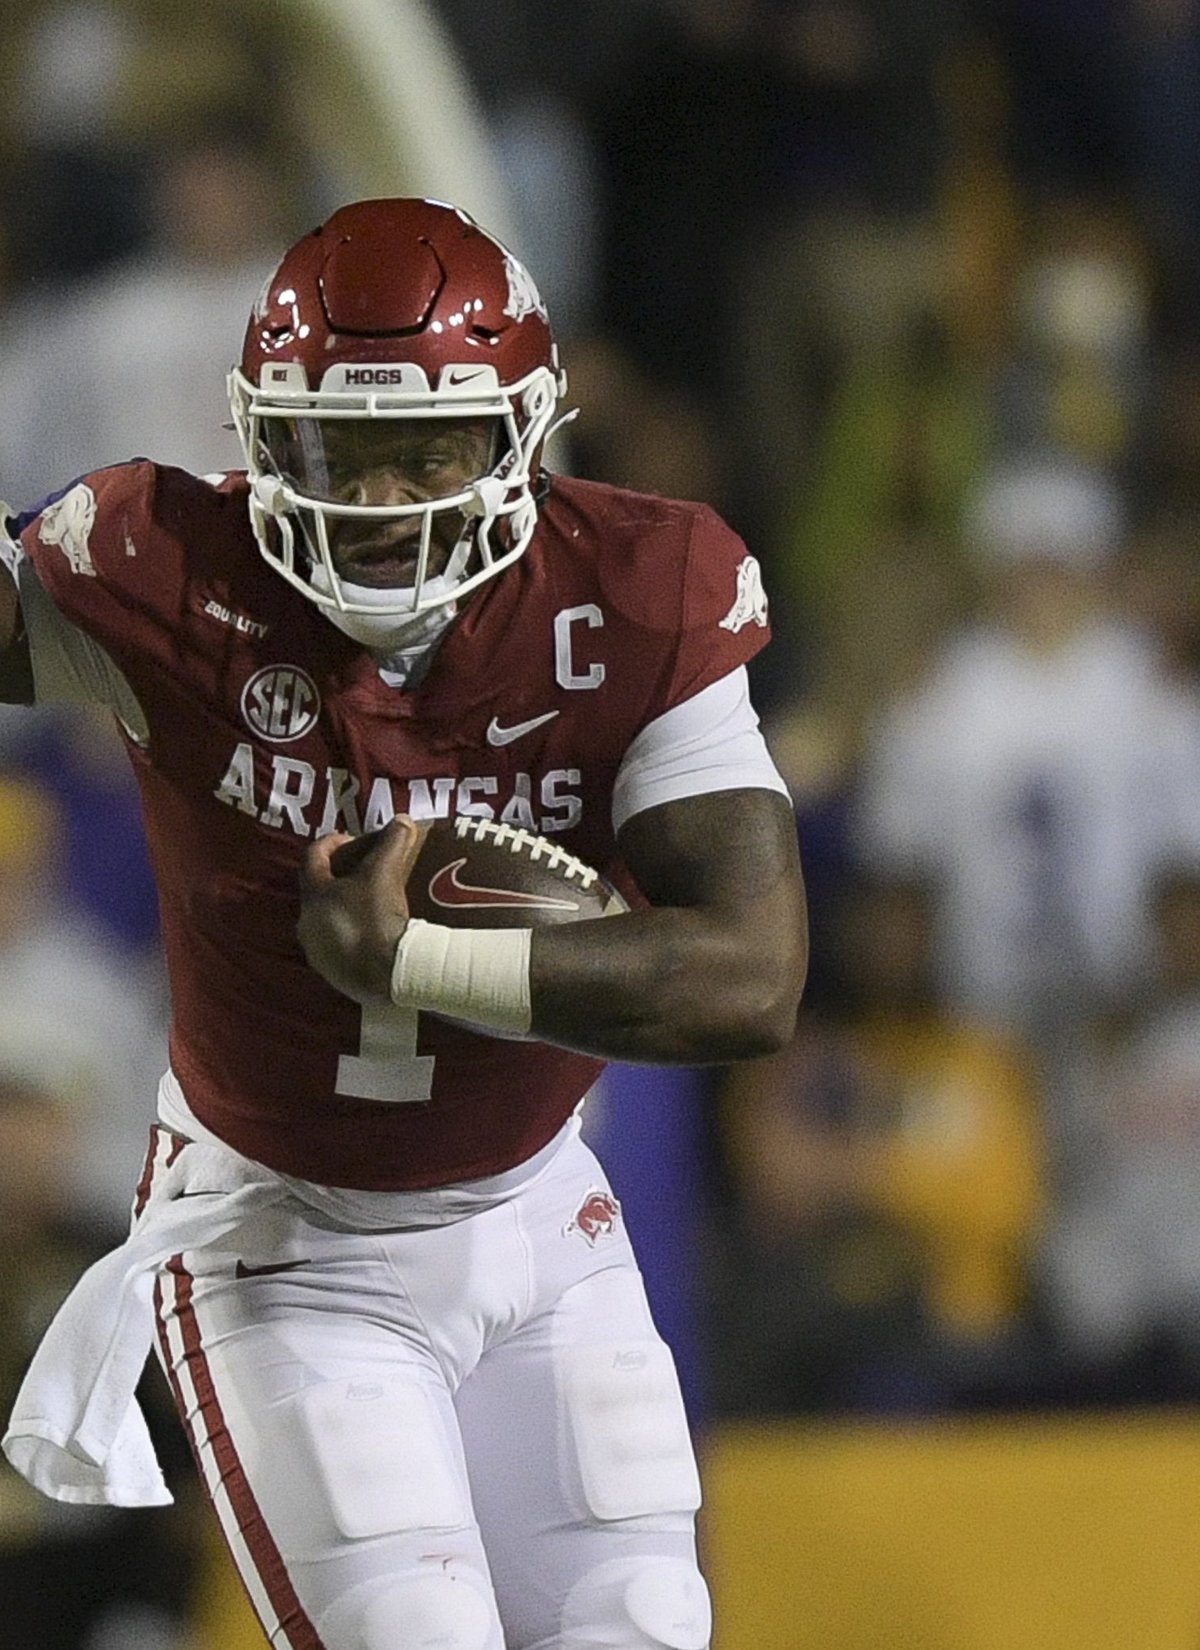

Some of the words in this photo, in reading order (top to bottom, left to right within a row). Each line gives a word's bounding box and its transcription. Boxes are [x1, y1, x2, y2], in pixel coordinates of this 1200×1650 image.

[345, 369, 402, 385] HOGS
[204, 600, 268, 638] EQUALITY
[554, 603, 606, 690] C
[249, 671, 312, 736] SEC
[213, 743, 583, 838] ARKANSAS
